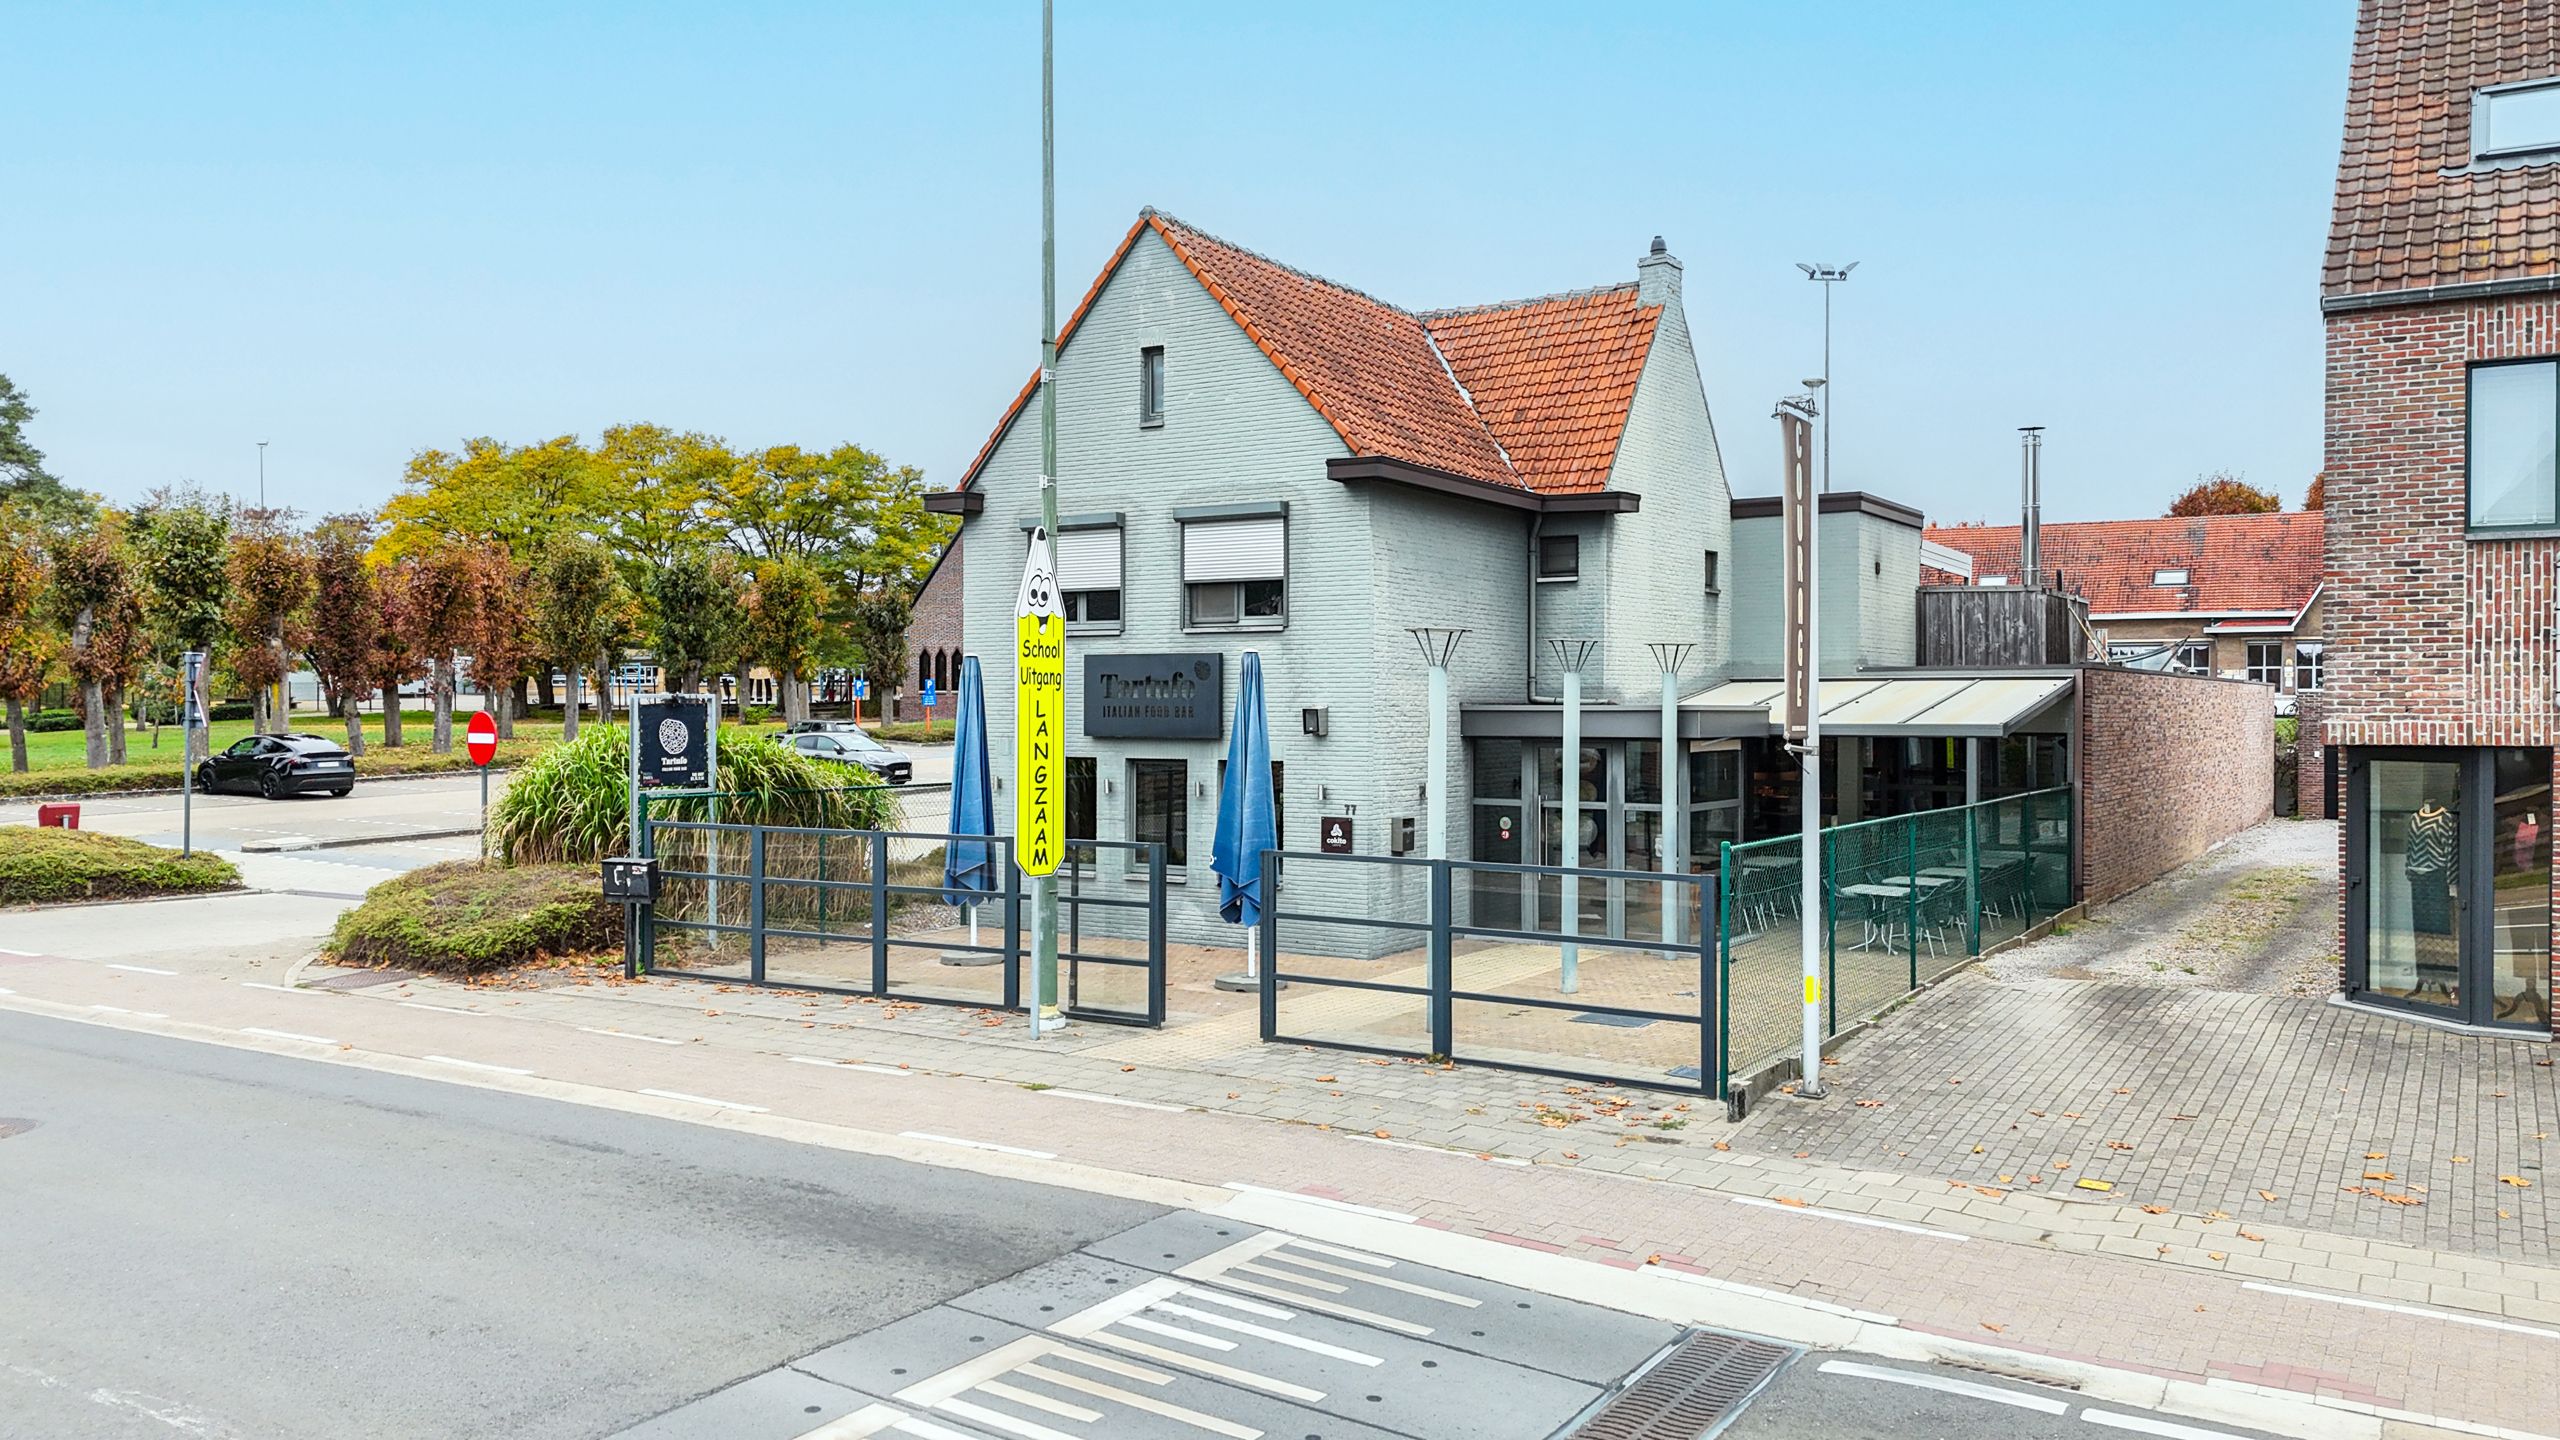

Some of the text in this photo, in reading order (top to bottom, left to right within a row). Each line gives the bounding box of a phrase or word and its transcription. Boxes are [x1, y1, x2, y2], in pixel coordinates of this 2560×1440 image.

[1022, 640, 1061, 659] School
[856, 681, 862, 690] P
[927, 680, 933, 689] P
[1020, 666, 1062, 691] Uitgang
[1100, 671, 1196, 700] Tartufo
[1102, 705, 1194, 718] ITALIAN FOOD BAR
[1033, 700, 1049, 866] LANGZAAM
[1344, 804, 1357, 815] 77
